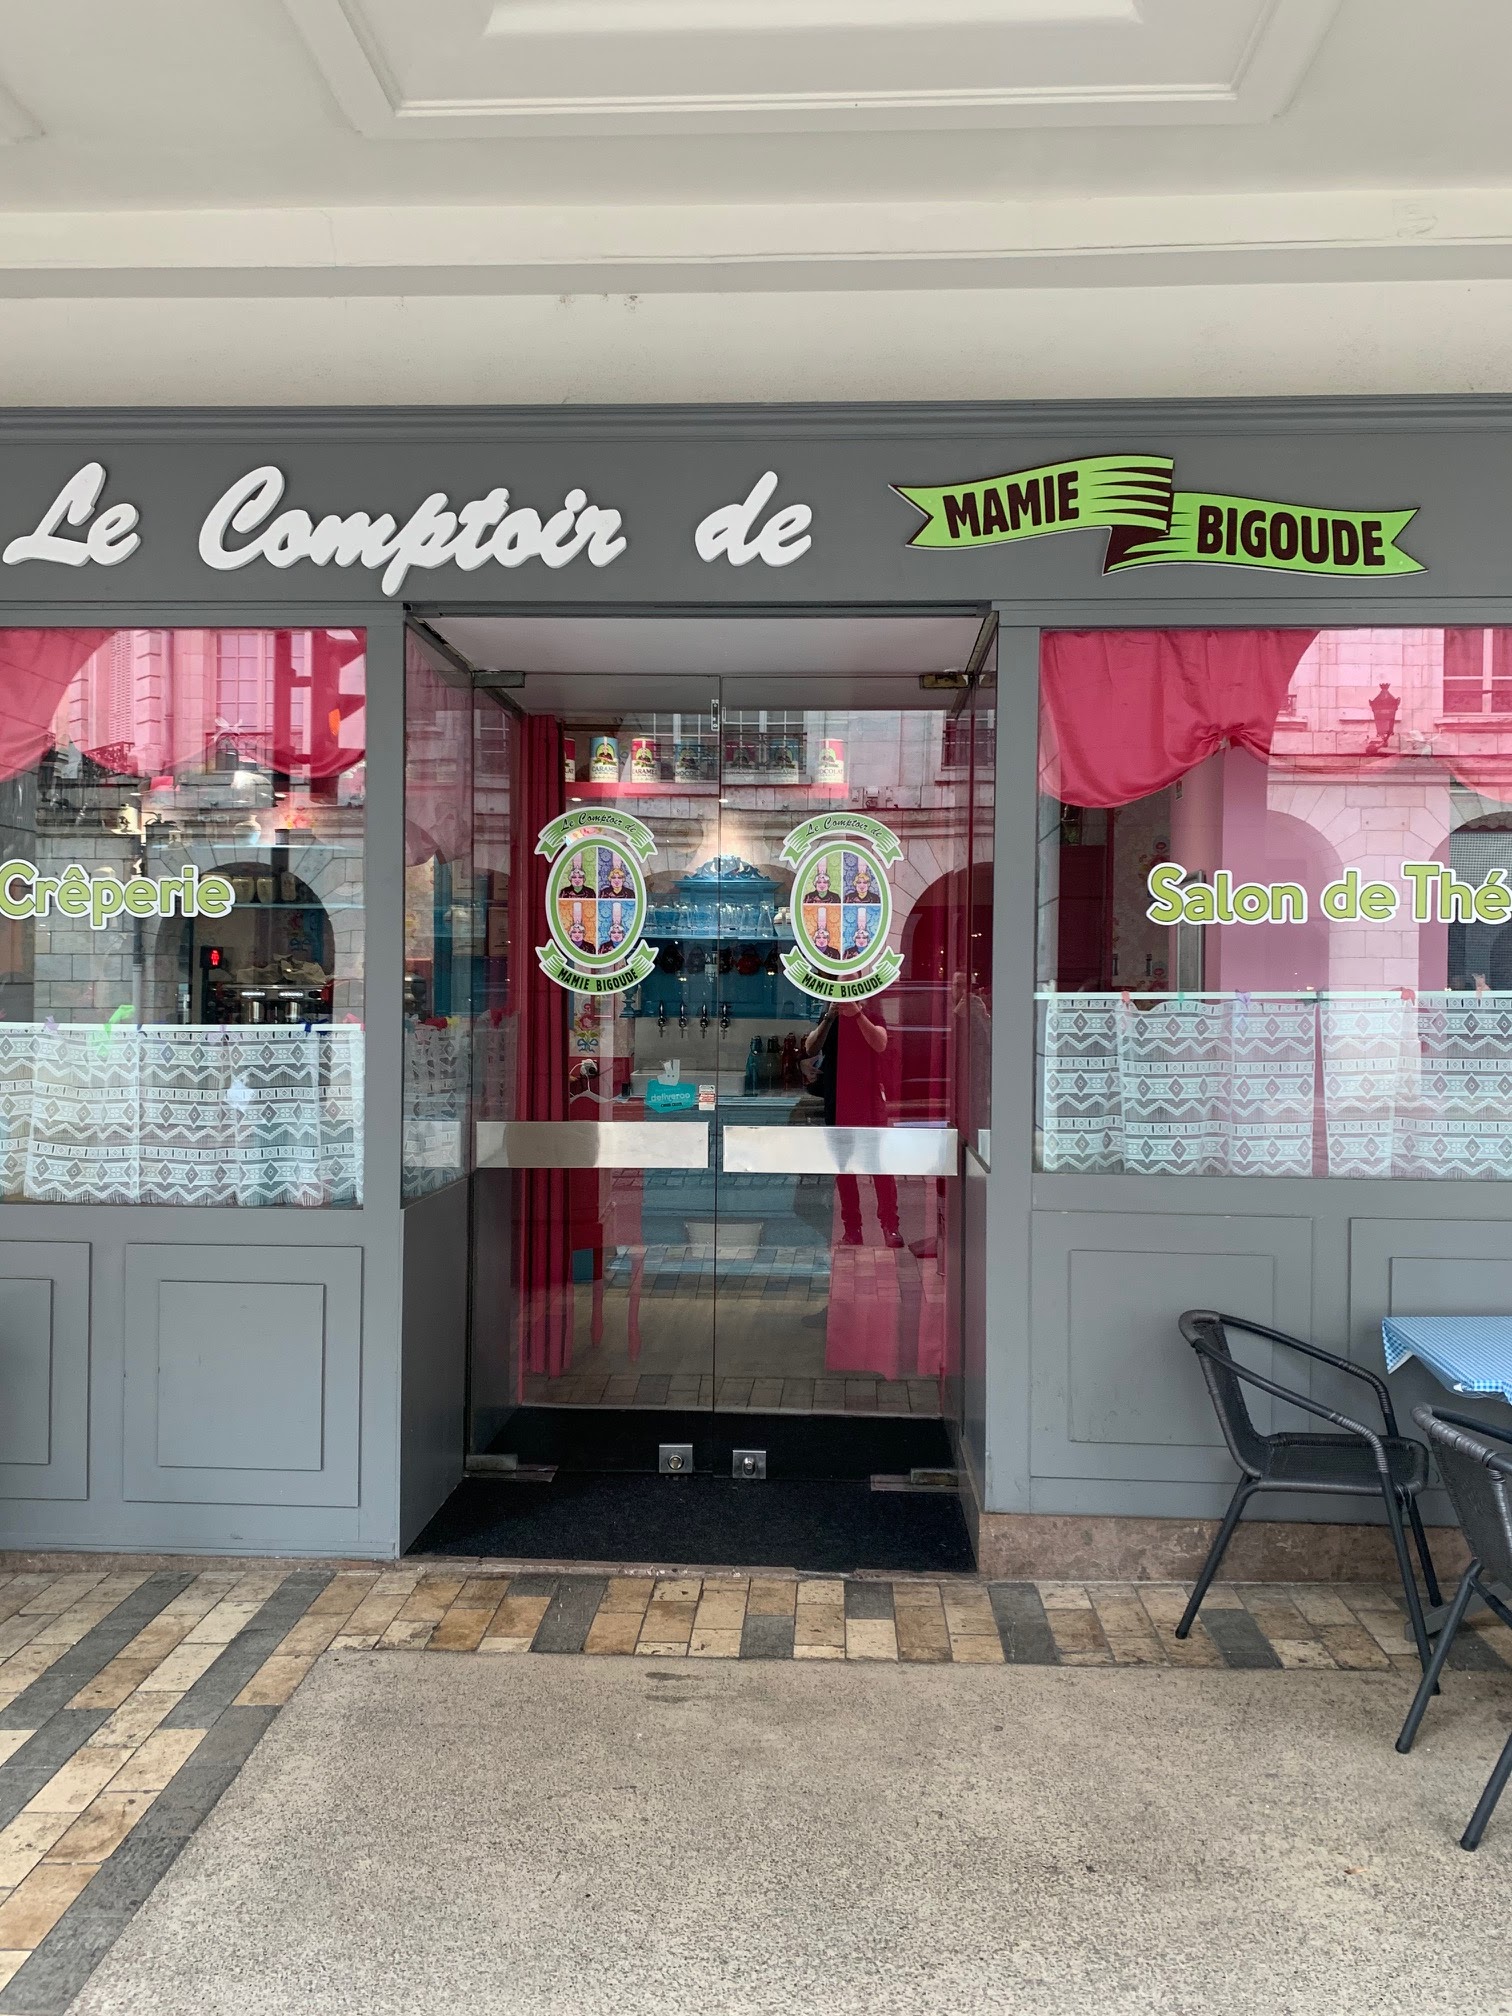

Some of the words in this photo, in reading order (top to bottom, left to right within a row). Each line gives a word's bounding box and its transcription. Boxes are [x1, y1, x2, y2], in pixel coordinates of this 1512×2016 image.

[3, 462, 141, 566] Le
[198, 465, 628, 597] Comptoir
[694, 471, 814, 566] de
[942, 470, 1080, 540] MAMIE
[1196, 505, 1387, 567] BIGOUDE
[561, 819, 574, 831] Le
[579, 813, 622, 825] Comptoir
[625, 824, 636, 832] de
[806, 824, 819, 836] Le
[824, 817, 868, 830] Comptoir
[871, 828, 882, 836] de
[0, 859, 235, 930] Crêperie
[1147, 863, 1307, 924] Salon
[1321, 868, 1399, 922] de
[1402, 862, 1512, 924] Thé
[557, 967, 590, 990] MAMIE
[596, 968, 638, 991] BIGOUDE
[801, 973, 834, 996] MAMIE
[840, 974, 883, 997] BIGOUDE
[651, 1092, 690, 1102] deliveroo
